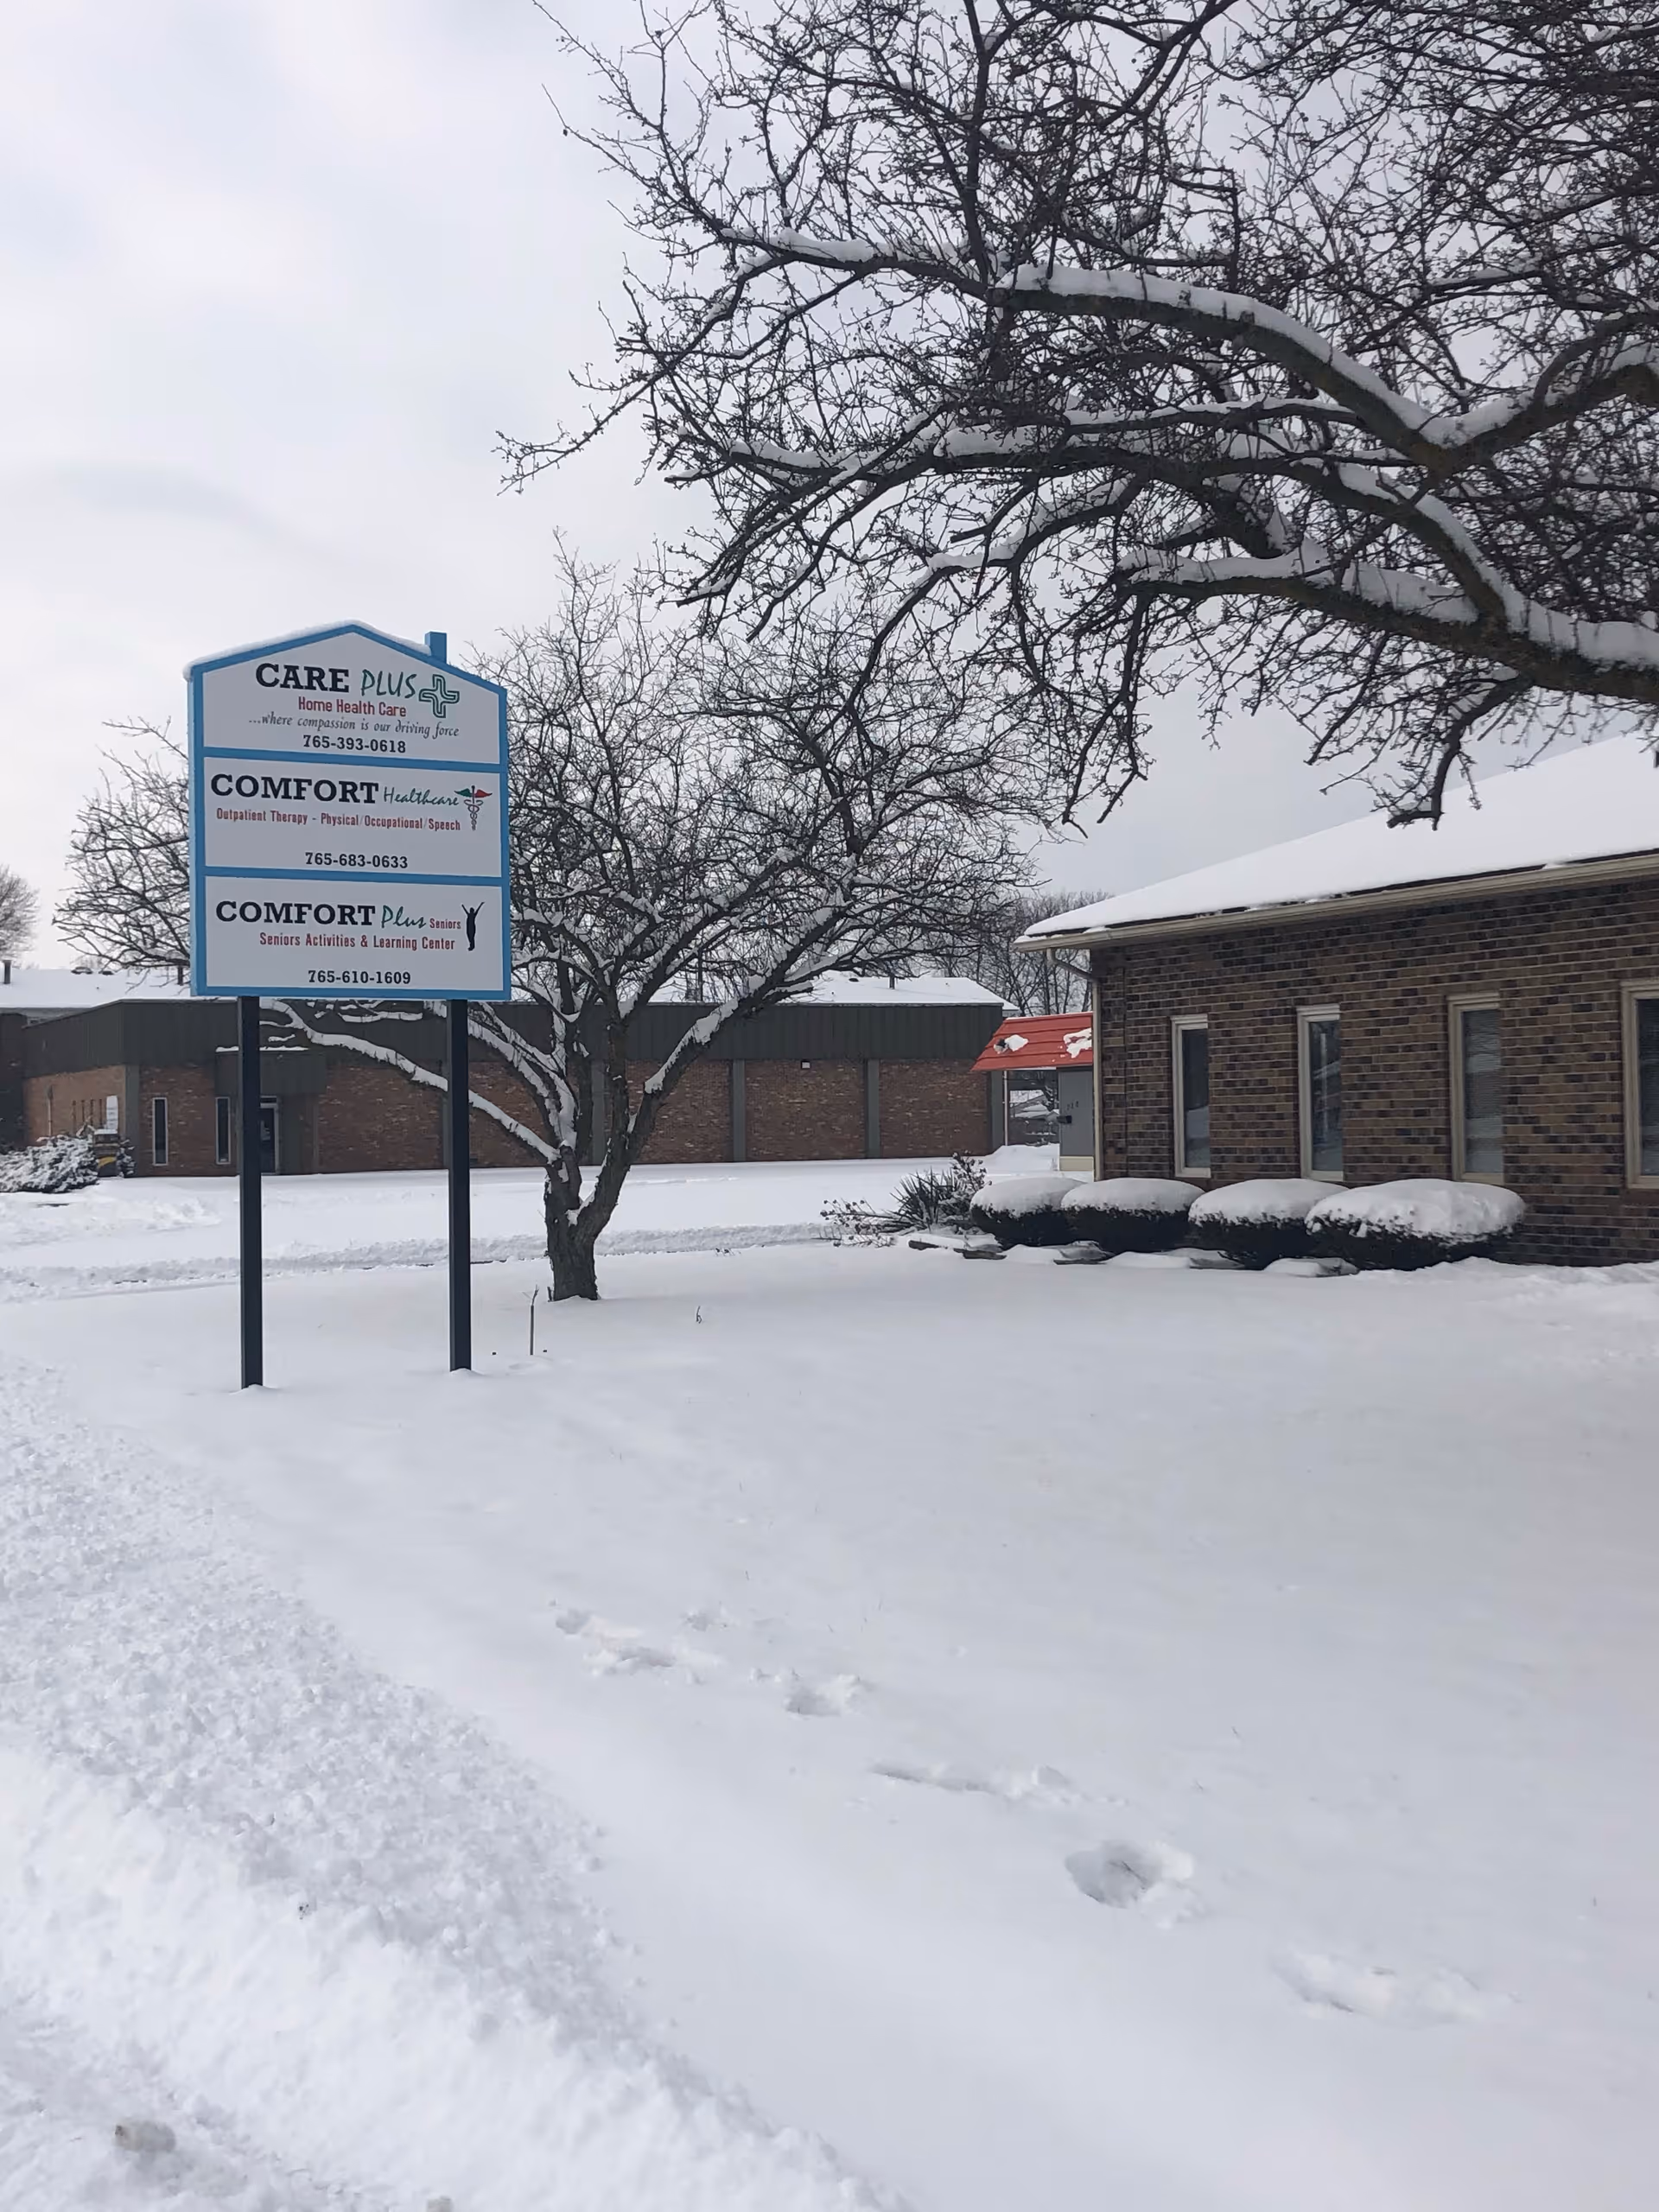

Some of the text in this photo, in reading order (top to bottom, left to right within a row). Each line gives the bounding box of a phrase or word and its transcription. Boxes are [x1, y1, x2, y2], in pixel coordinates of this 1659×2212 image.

[256, 663, 416, 699] CARE PLUS
[298, 696, 406, 717] Home Health Care
[297, 716, 355, 731] compassion
[361, 719, 369, 731] is
[373, 722, 391, 732] our
[395, 719, 430, 739] driving
[432, 721, 460, 740] force
[302, 734, 406, 753] 765-393-0618
[211, 773, 459, 806] COMFORT Healthcare
[217, 808, 266, 822] Outpatient
[270, 810, 308, 825] Therapy
[305, 852, 408, 868] 765-683-0633
[216, 900, 461, 930] COMFORT Plus Seniors
[260, 932, 455, 950] Seniors Activities & Learning Center
[308, 969, 411, 984] 765-610-1609
